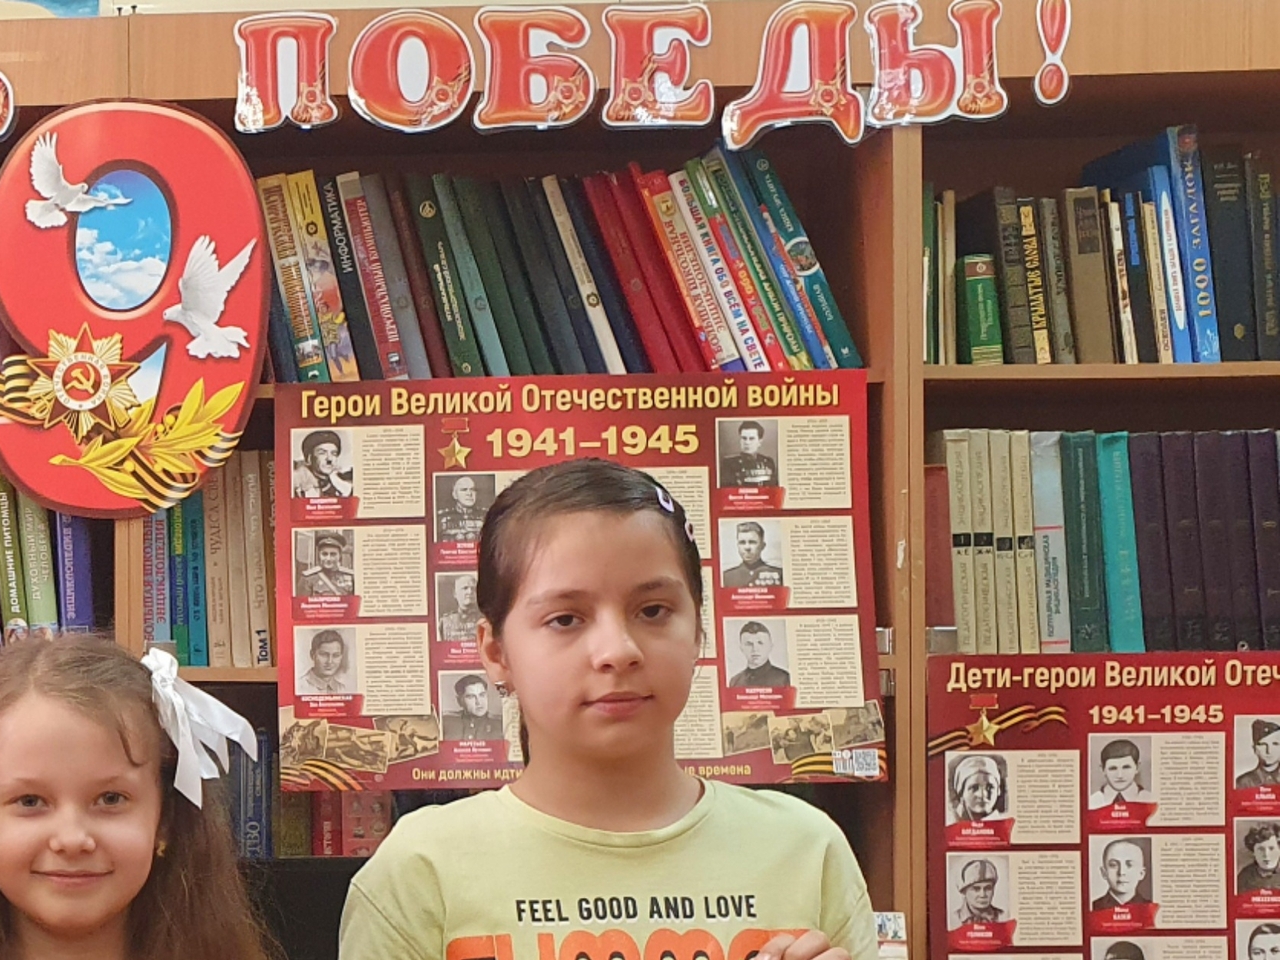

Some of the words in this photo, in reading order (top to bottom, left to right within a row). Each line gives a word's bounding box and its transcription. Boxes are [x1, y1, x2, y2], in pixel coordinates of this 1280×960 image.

[233, 0, 1071, 151] ПОБЕДЫ!
[323, 182, 354, 273] ИНФОРМАТИКА
[679, 179, 708, 229] БОЛЬШАЯ
[700, 229, 716, 267] КНИГА
[714, 267, 730, 290] ОБО
[736, 319, 750, 336] НА
[743, 336, 765, 370] СВЕТЕ
[1193, 257, 1213, 318] 1000
[301, 389, 381, 424] Герои
[390, 384, 512, 416] Великой
[521, 378, 738, 412] Отечественной
[747, 377, 839, 406] войны
[0, 491, 13, 548] ПИТОМЦЫ
[25, 507, 36, 533] МИР
[208, 505, 223, 555] ЧУДЕСА
[5, 550, 21, 613] ДОМАШНИЕ
[27, 534, 42, 601] ДУХОВНЫЙ
[154, 518, 166, 625] ЭНЦИКЛОПЕДИЯ
[143, 580, 156, 642] БОЛЬШАЯ
[257, 636, 269, 665] Том
[946, 661, 1096, 693] Дети-герои
[1105, 659, 1217, 688] Великой
[412, 767, 435, 781] Они
[438, 768, 491, 783] должны
[698, 765, 752, 778] времена
[516, 898, 570, 923] FEEL
[578, 896, 639, 922] GOOD
[649, 895, 695, 920] AND
[704, 895, 758, 919] LOVE
